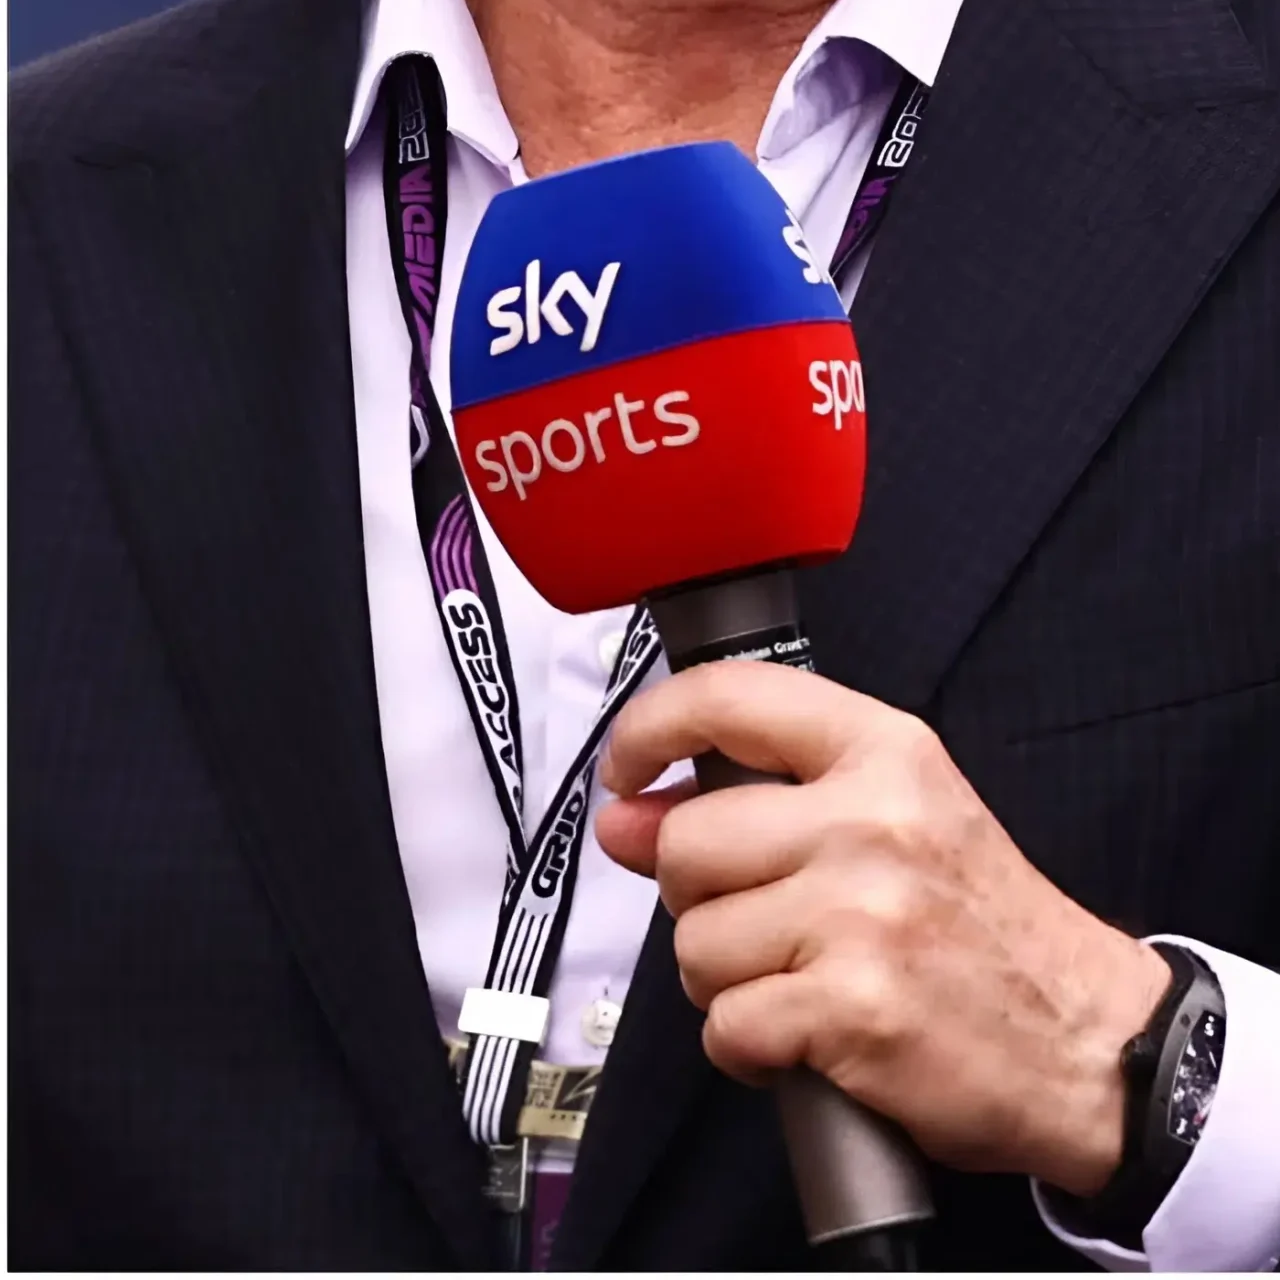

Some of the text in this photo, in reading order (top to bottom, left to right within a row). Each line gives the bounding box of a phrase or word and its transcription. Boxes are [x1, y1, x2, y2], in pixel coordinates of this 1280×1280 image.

[486, 259, 622, 357] sky
[475, 390, 701, 502] sports
[447, 602, 521, 772] ACCESS
[531, 791, 584, 899] GRID
